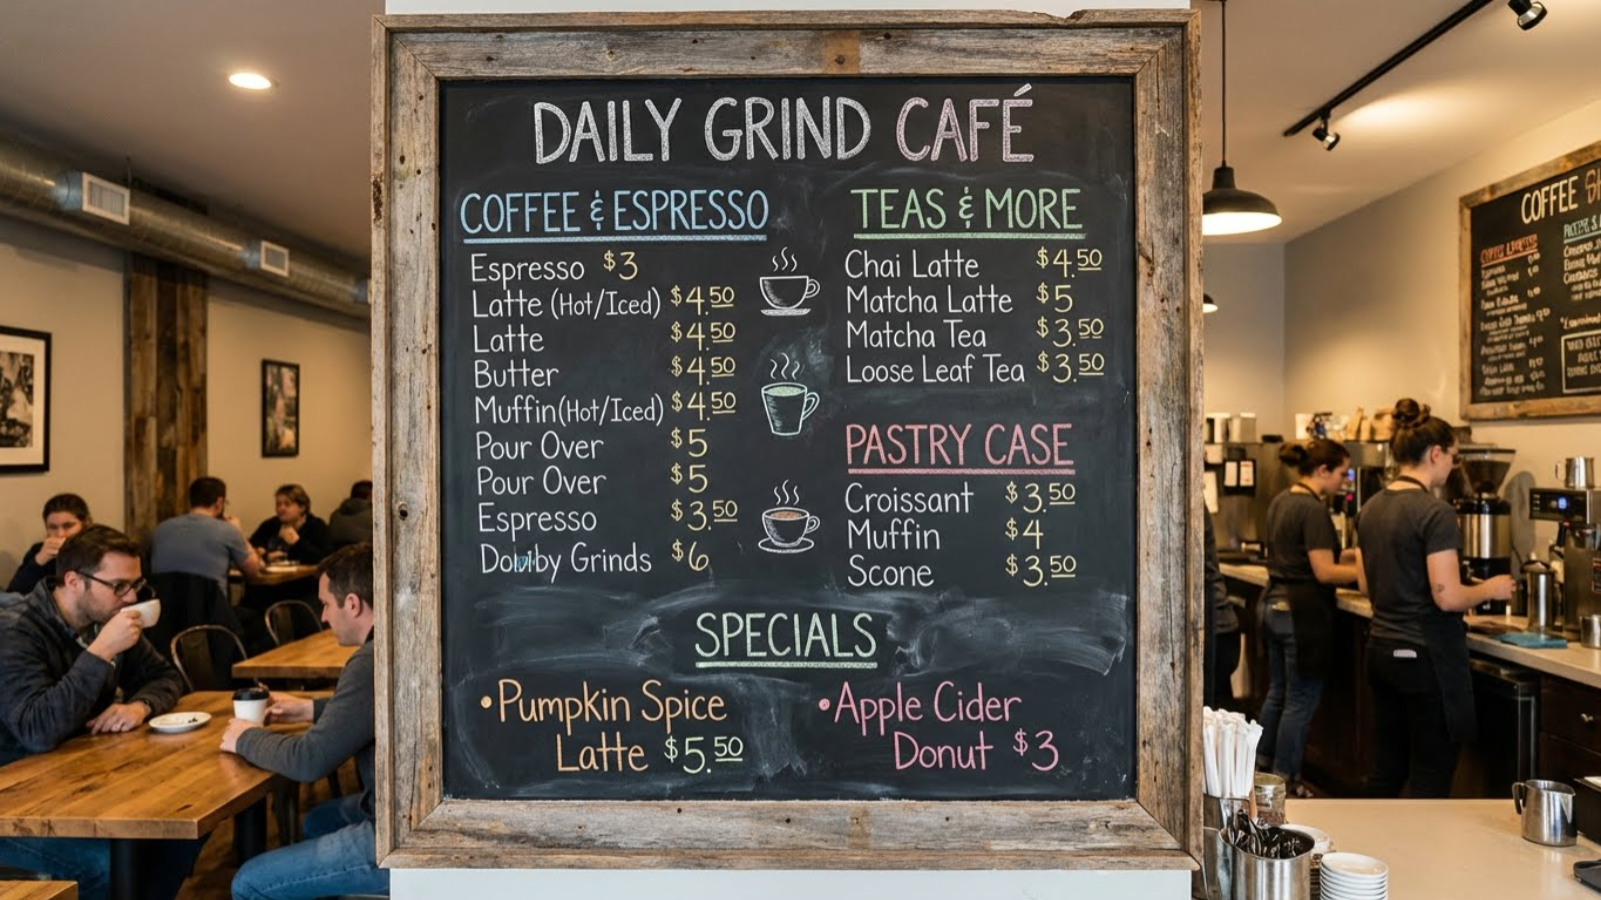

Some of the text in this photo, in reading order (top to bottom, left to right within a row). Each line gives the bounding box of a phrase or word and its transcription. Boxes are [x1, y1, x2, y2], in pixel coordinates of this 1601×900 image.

[533, 82, 1035, 165] DAILY GRIND CAFÉ
[460, 189, 769, 234] COFFEE & ESPRESSO
[850, 186, 1083, 230] TEAS & MORE
[1521, 175, 1579, 224] COFFEE
[470, 249, 638, 290] Espresso $3
[844, 245, 1103, 279] Chai Latte $4.50
[472, 284, 735, 320] Latte (Hot/Iced) $4.50
[846, 281, 1073, 314] Matcha Latte $5
[473, 320, 736, 353] Latte $4.50
[846, 315, 1105, 349] Matcha Tea $3.50
[474, 355, 736, 389] Butter $4.50
[846, 350, 1105, 384] Loose Leaf Tea $3.50
[671, 390, 737, 421] $4.50
[475, 426, 708, 461] Pour Over $5
[846, 423, 1074, 466] PASTRY CASE
[477, 462, 708, 496] Pour Over $5
[844, 480, 1076, 514] Croissant $3.50
[478, 498, 738, 542] Espresso $3.50
[847, 517, 1044, 550] Muffin $4
[570, 541, 652, 573] Grinds
[671, 538, 710, 572] $6
[847, 553, 1077, 587] Scone $3.50
[695, 611, 879, 658] SPECIALS
[498, 678, 728, 733] Pumpkin Spice
[834, 680, 1022, 736] Apple Cider
[556, 733, 744, 775] Latte $5.50
[893, 727, 1059, 772] Donut $3
